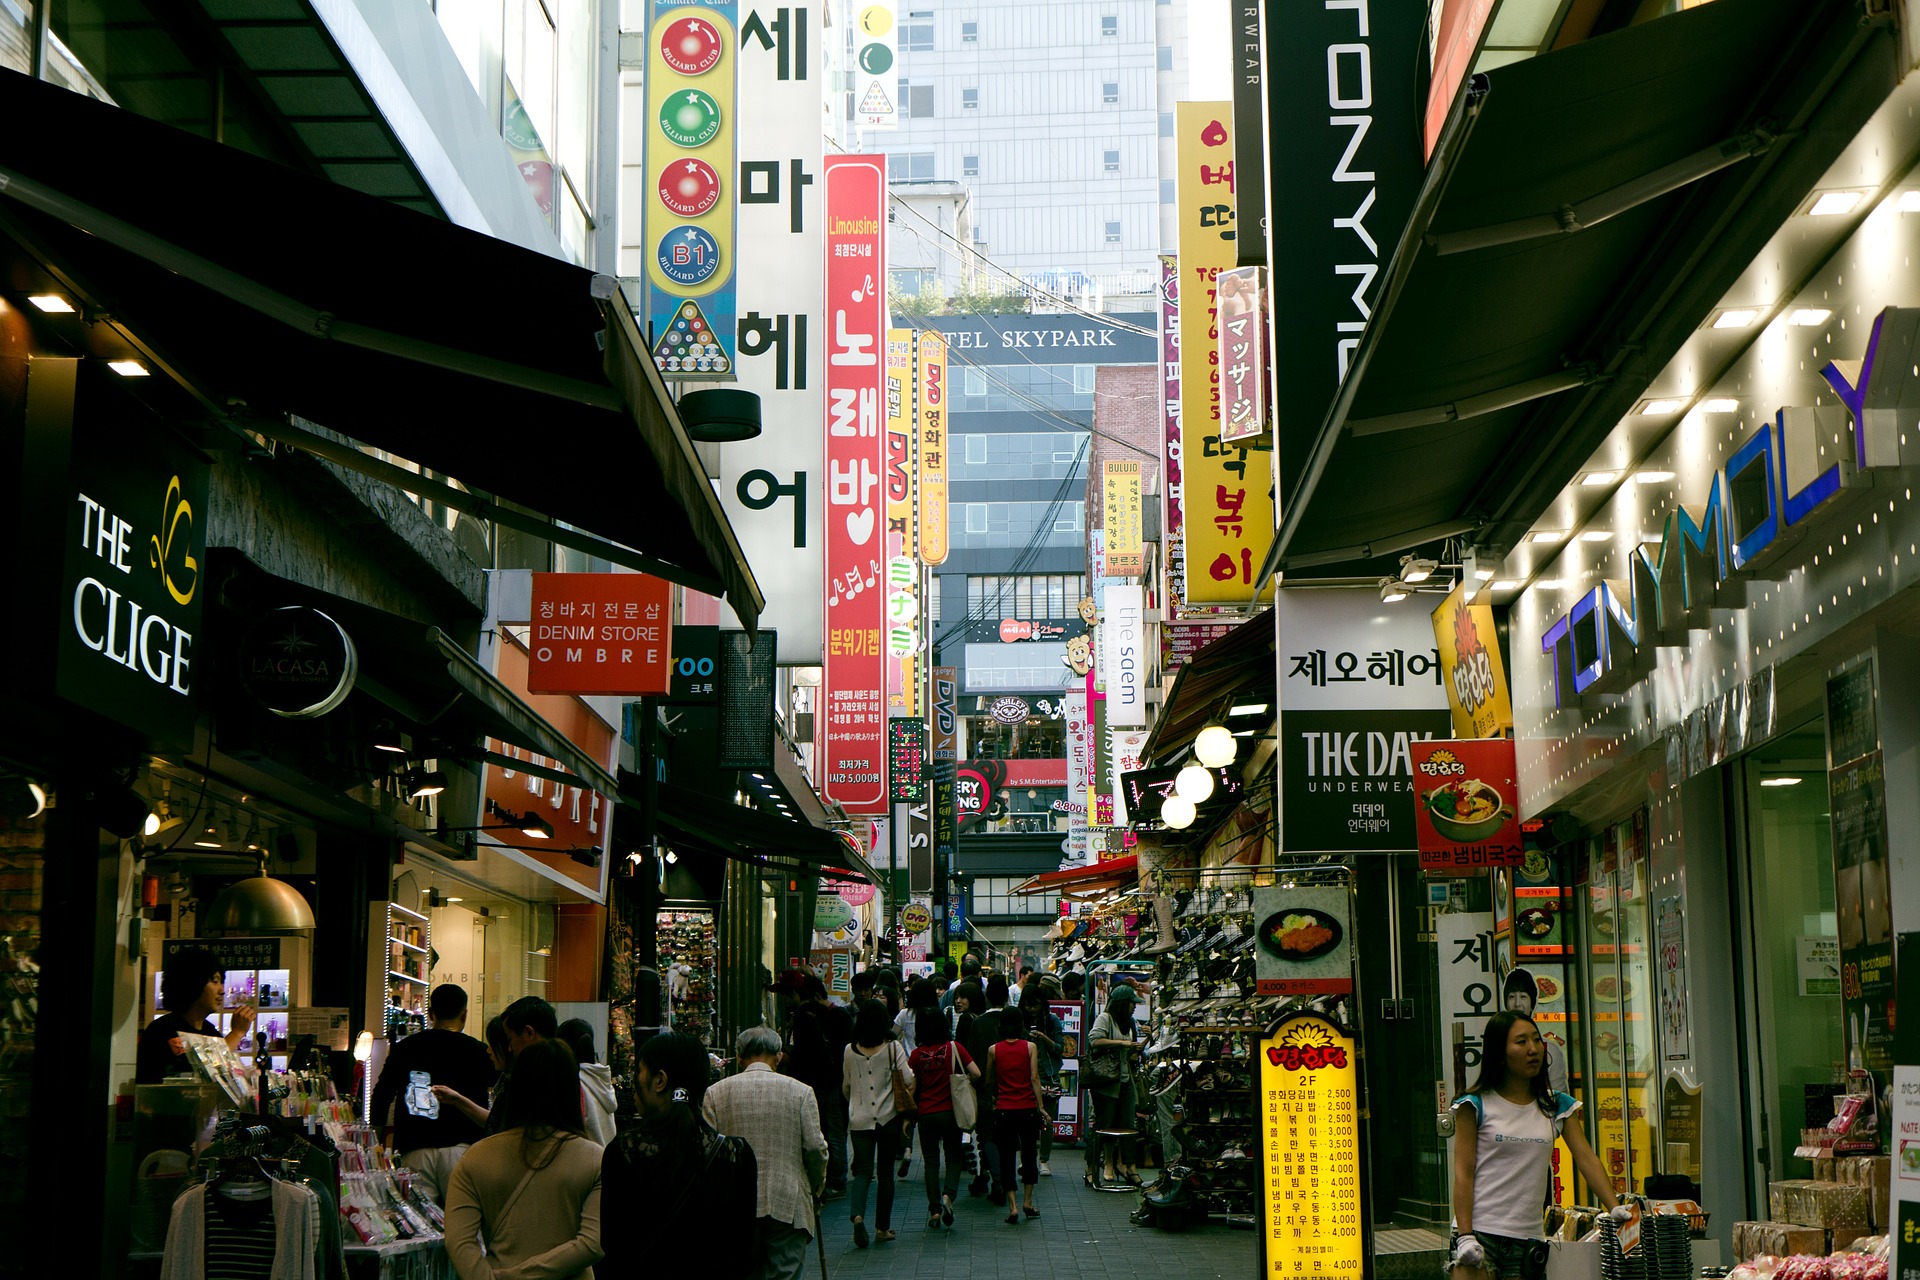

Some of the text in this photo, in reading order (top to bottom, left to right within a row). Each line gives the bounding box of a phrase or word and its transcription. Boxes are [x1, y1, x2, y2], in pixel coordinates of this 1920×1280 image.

[662, 47, 718, 71] BILLIARD CLUB
[661, 118, 717, 143] BILLIARD CLUB
[660, 188, 716, 212] BILLIARD CLUB
[829, 216, 878, 237] Limousine
[673, 245, 704, 265] B1
[660, 256, 716, 280] BILLIARD CLUB
[736, 8, 813, 548] 세마헤어
[1002, 329, 1116, 348] SKYPARK
[1226, 317, 1252, 423] マッサージ
[926, 363, 941, 405] DVD
[830, 309, 878, 505] 노래방
[1244, 420, 1258, 433] 3F
[924, 410, 942, 469] 영화관
[1108, 463, 1138, 472] BULUJO
[1541, 306, 1890, 709] TONYMOLY
[77, 492, 133, 574] THE
[1110, 556, 1139, 566] 부르조
[539, 601, 660, 619] 청바지 전문샵
[74, 576, 192, 696] CLIGE
[539, 625, 659, 641] DENIM STORE
[830, 628, 879, 657] 분위기캡
[537, 647, 657, 664] OMBRE
[1120, 607, 1138, 705] the saem
[251, 658, 329, 675] LACASA
[1288, 649, 1442, 687] 제오헤어
[690, 684, 713, 694] 크루
[932, 679, 955, 736] DVD
[995, 698, 1026, 710] ASHLEY
[839, 759, 869, 769] 최저가격
[1301, 732, 1432, 777] THE DA
[1420, 762, 1465, 776] 명화당
[1352, 803, 1384, 817] 더데이
[1348, 819, 1390, 833] 언더웨어
[1422, 844, 1522, 864] 따끈한 냄비국수
[906, 912, 928, 923] DVD
[832, 953, 848, 991] ミナミ
[1263, 983, 1287, 991] 4,000
[1299, 1076, 1316, 1086] 2F
